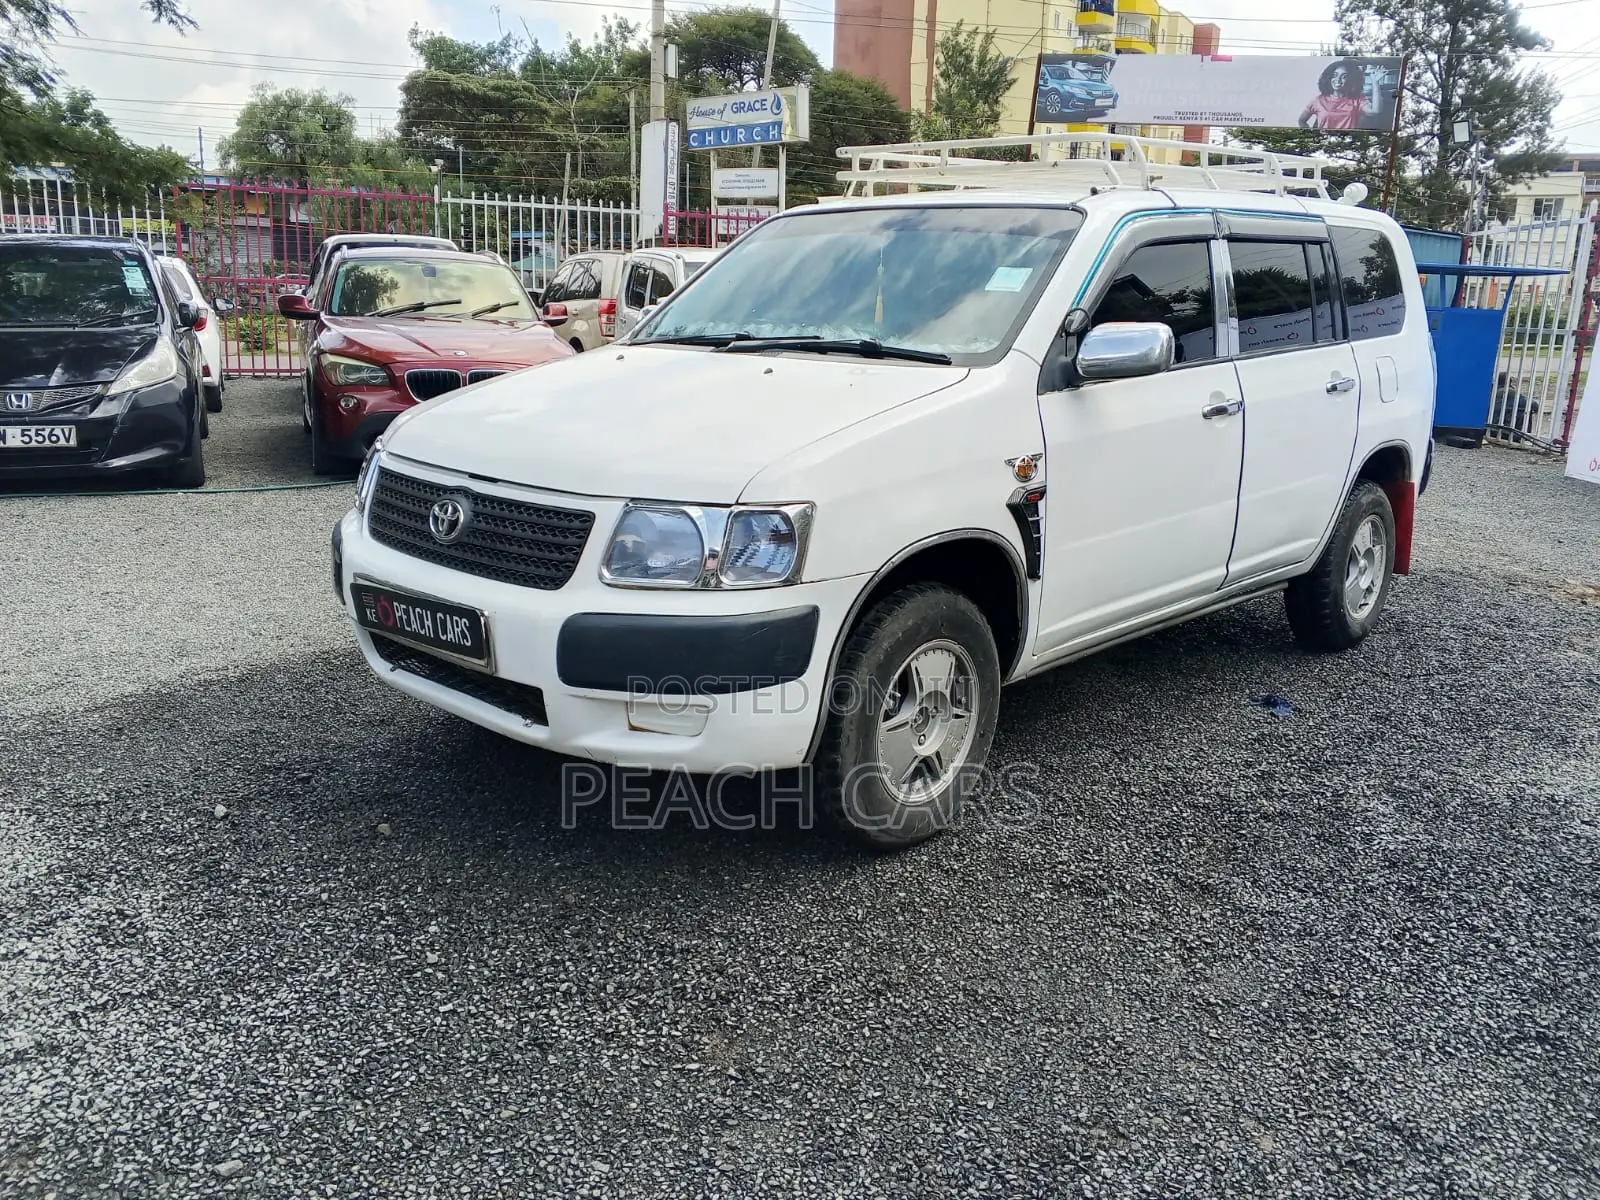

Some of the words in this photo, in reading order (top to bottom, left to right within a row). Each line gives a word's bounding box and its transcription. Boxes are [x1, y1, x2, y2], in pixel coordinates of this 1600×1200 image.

[688, 106, 716, 120] House
[717, 102, 728, 120] of
[731, 98, 768, 114] GRACE
[690, 125, 778, 146] CHURCH
[20, 428, 73, 445] 556V
[366, 607, 378, 623] KE
[393, 601, 434, 638] PEACH
[436, 612, 472, 646] CARS
